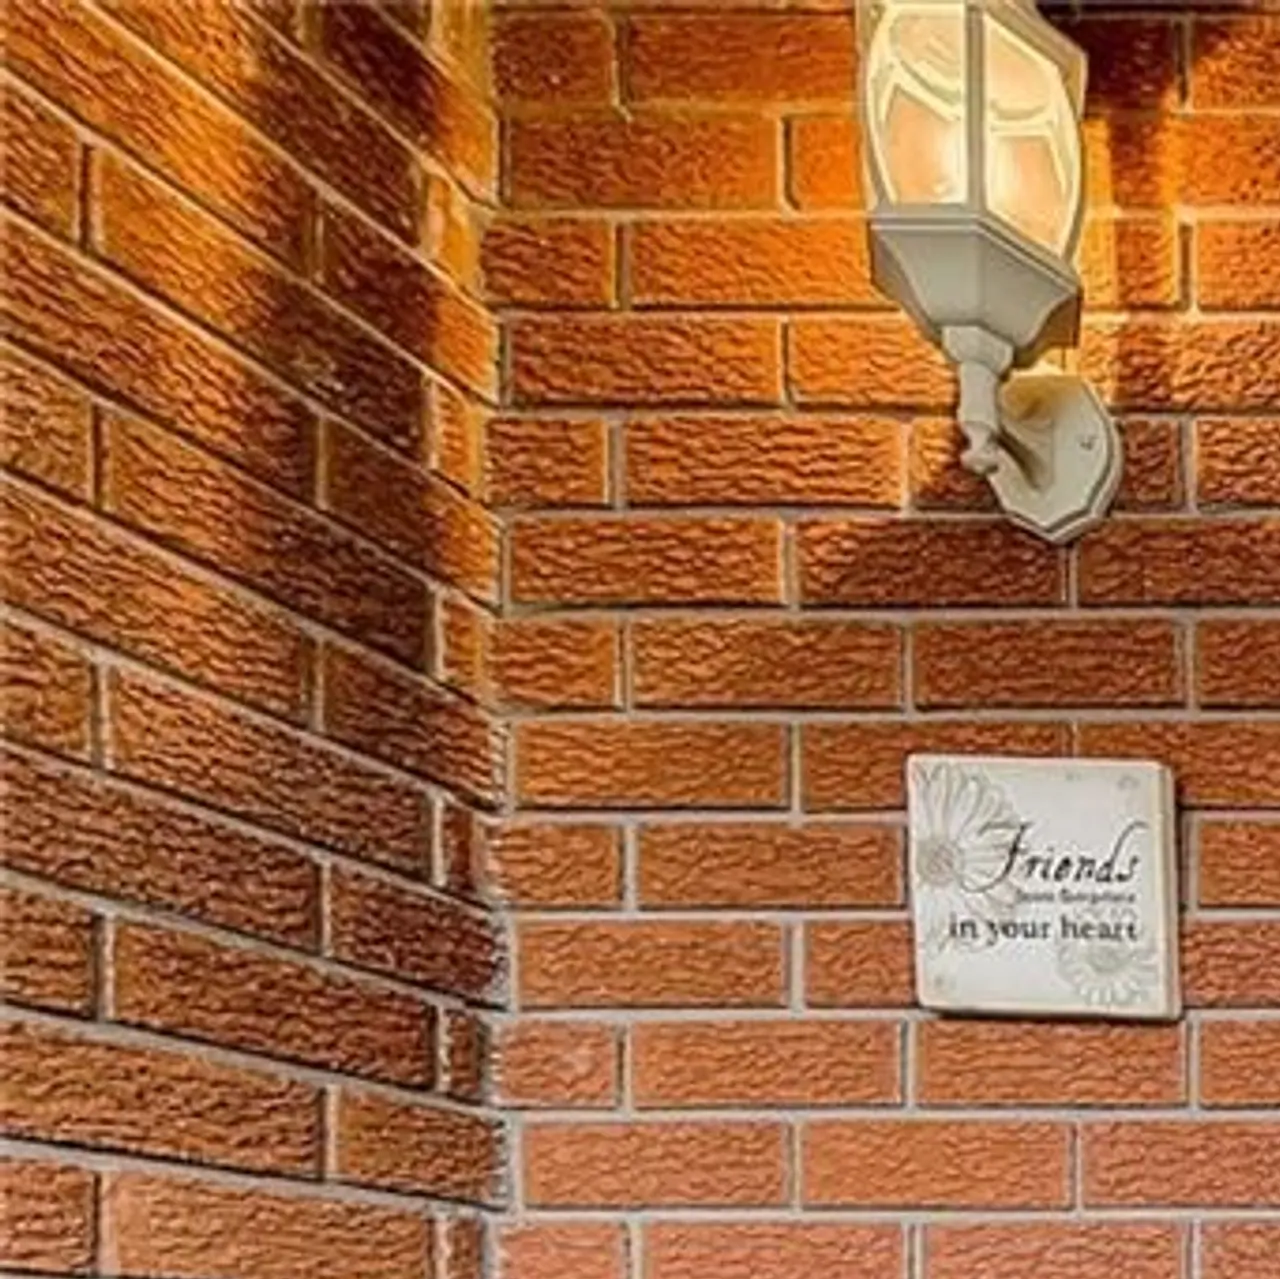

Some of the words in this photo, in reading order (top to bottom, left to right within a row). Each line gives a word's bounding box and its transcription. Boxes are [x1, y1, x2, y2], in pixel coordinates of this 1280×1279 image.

[967, 821, 1148, 893] Friends
[950, 913, 979, 939] in
[987, 919, 1051, 946] your
[1061, 914, 1138, 942] heart
